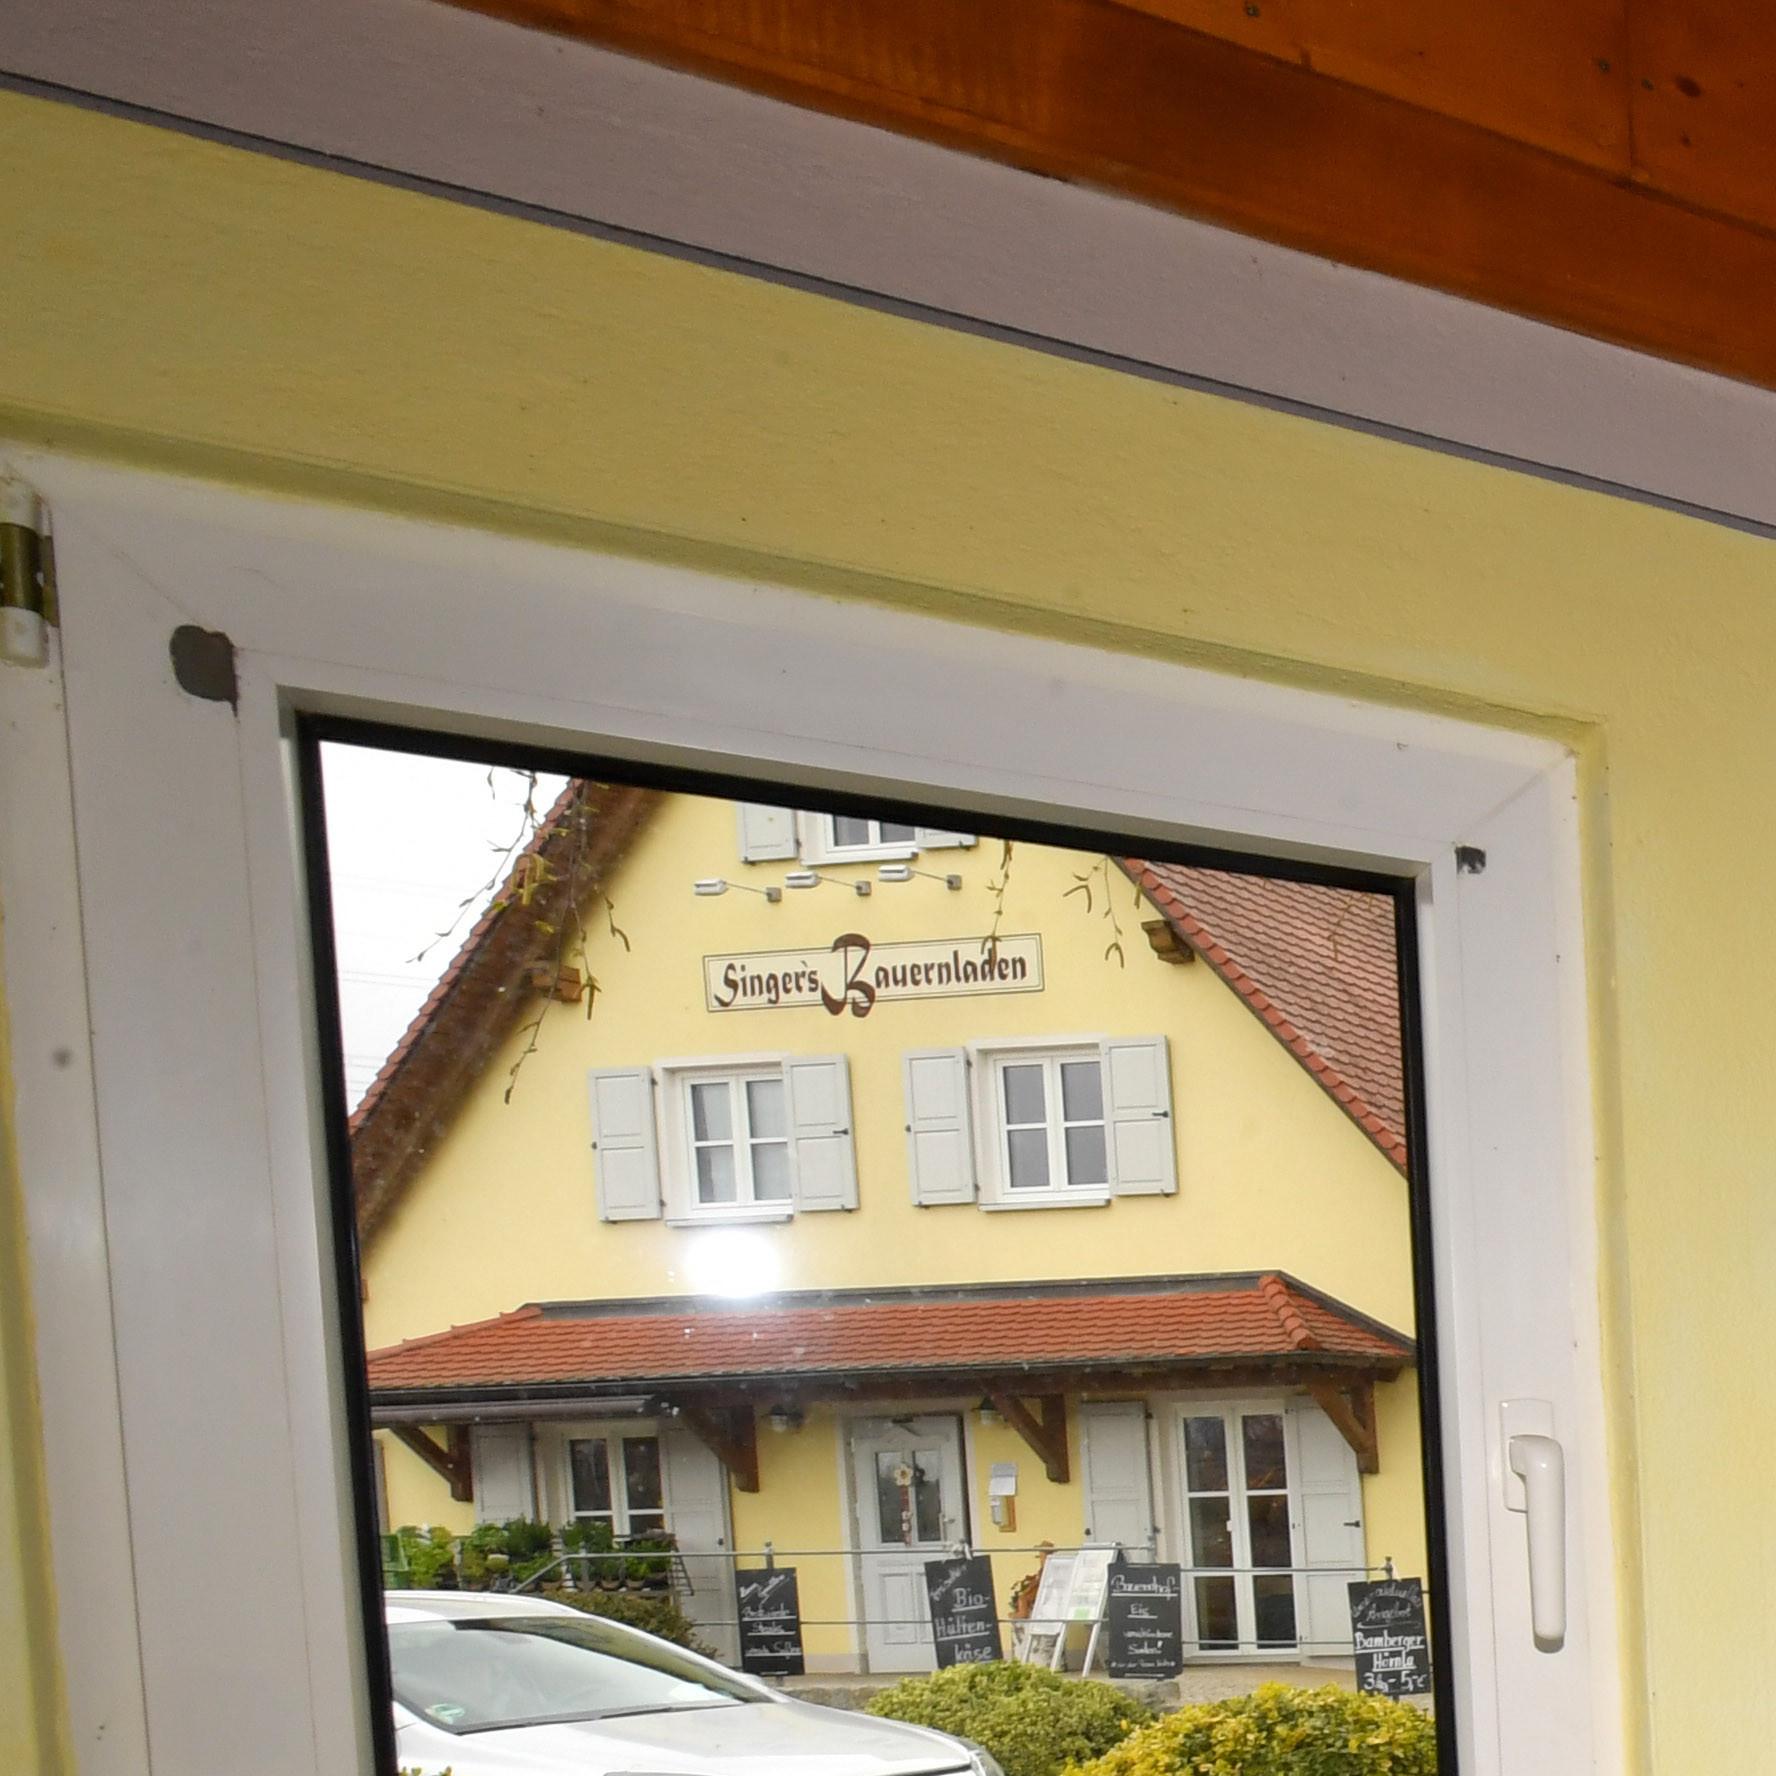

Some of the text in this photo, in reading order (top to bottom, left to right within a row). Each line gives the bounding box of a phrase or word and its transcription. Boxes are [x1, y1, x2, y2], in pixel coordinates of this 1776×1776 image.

[820, 933, 1028, 1018] Bauernladen
[953, 1587, 990, 1607] Bio-
[1355, 1629, 1425, 1651] Bamberger
